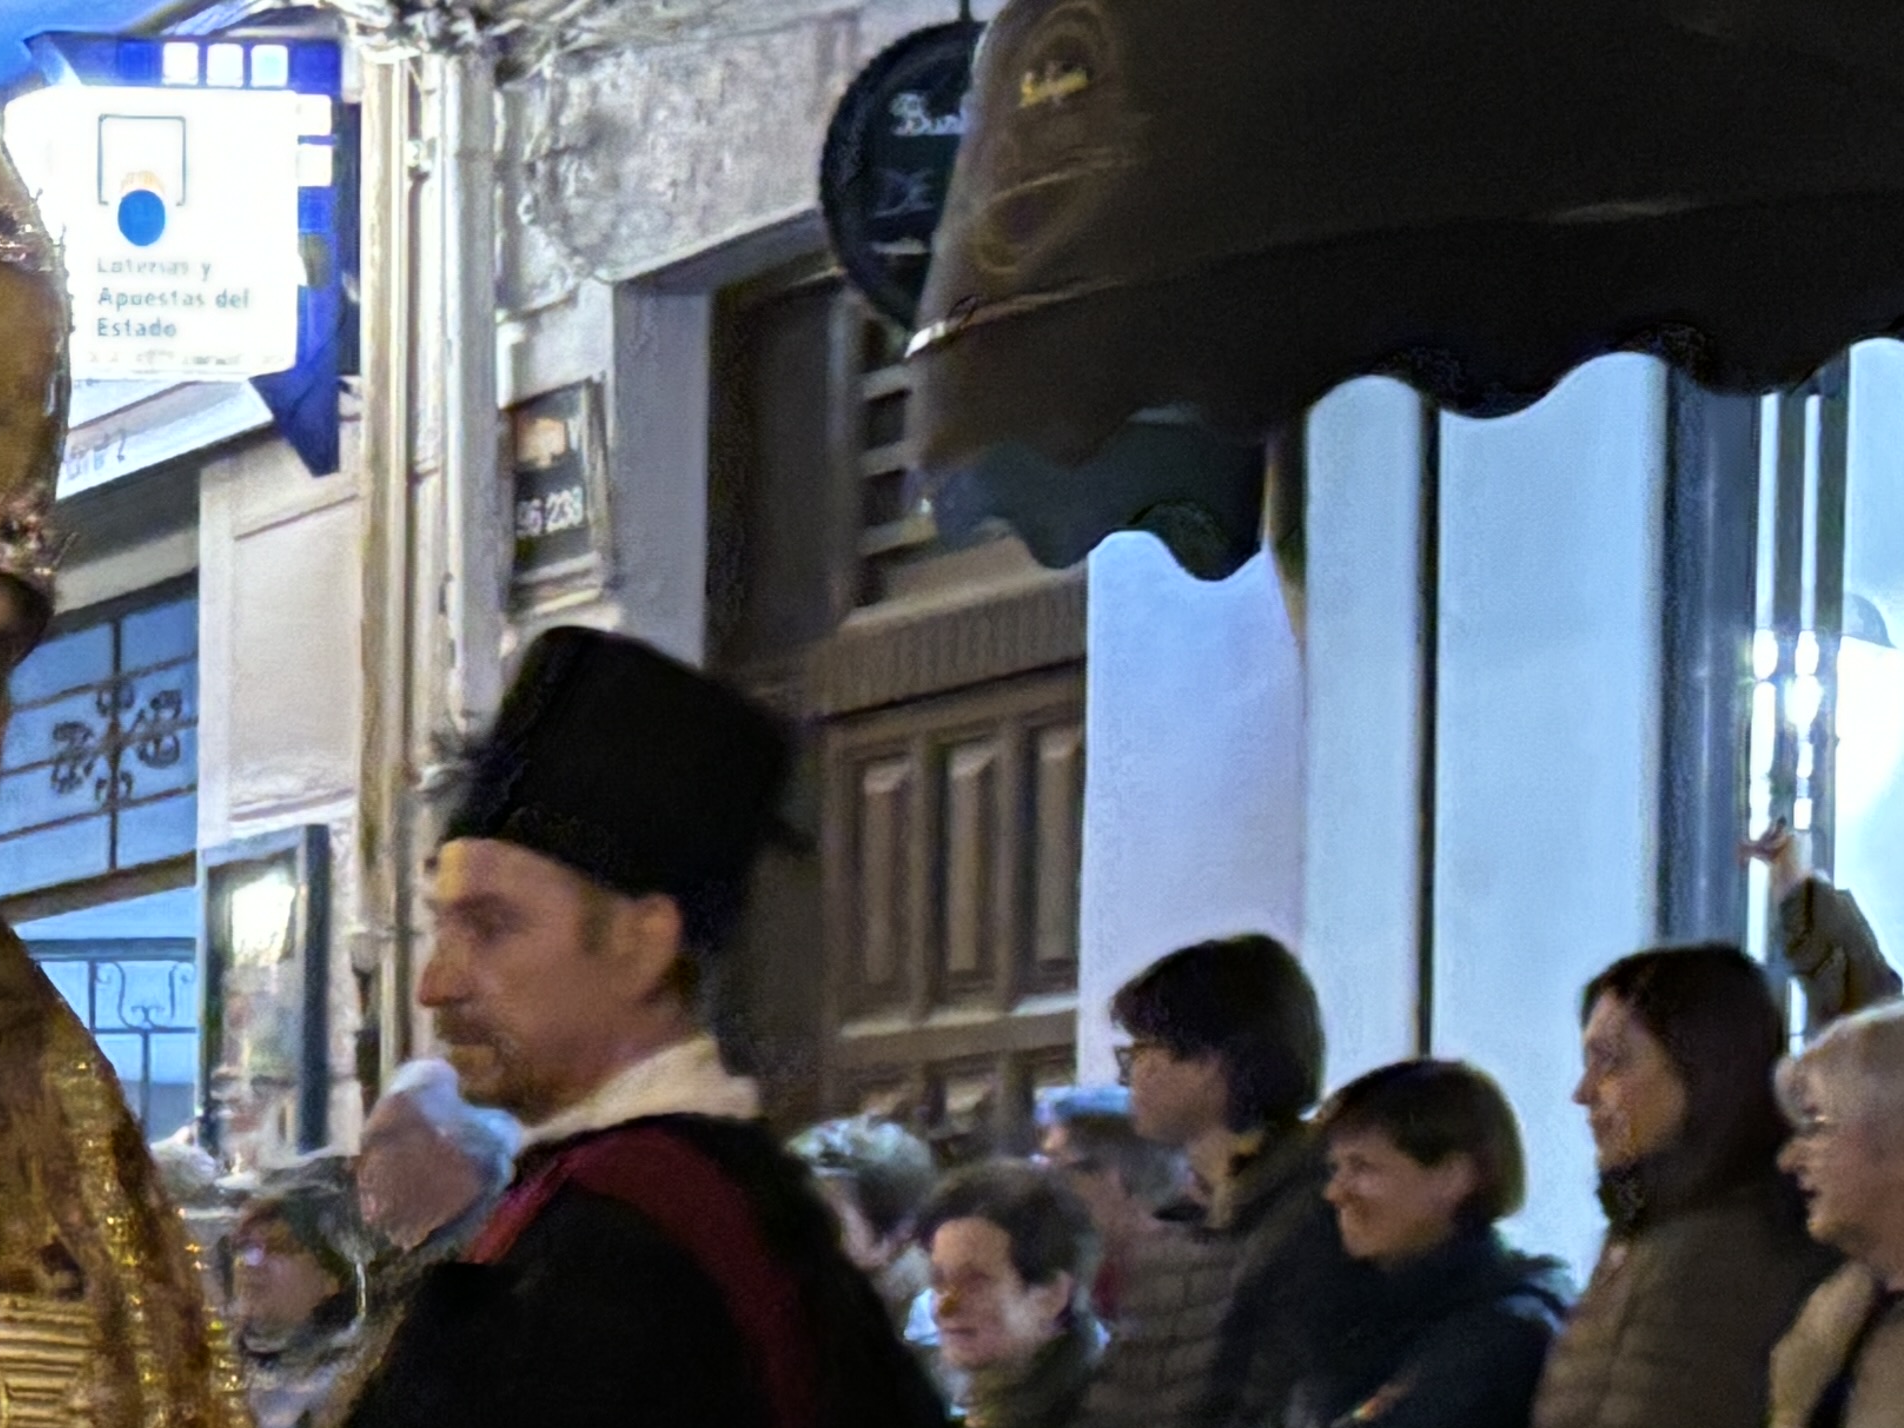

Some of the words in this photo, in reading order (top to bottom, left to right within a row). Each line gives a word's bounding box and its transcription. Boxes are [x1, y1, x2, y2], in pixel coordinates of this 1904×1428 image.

[97, 287, 205, 312] Apuestas
[215, 288, 250, 308] del
[97, 316, 177, 337] Estado
